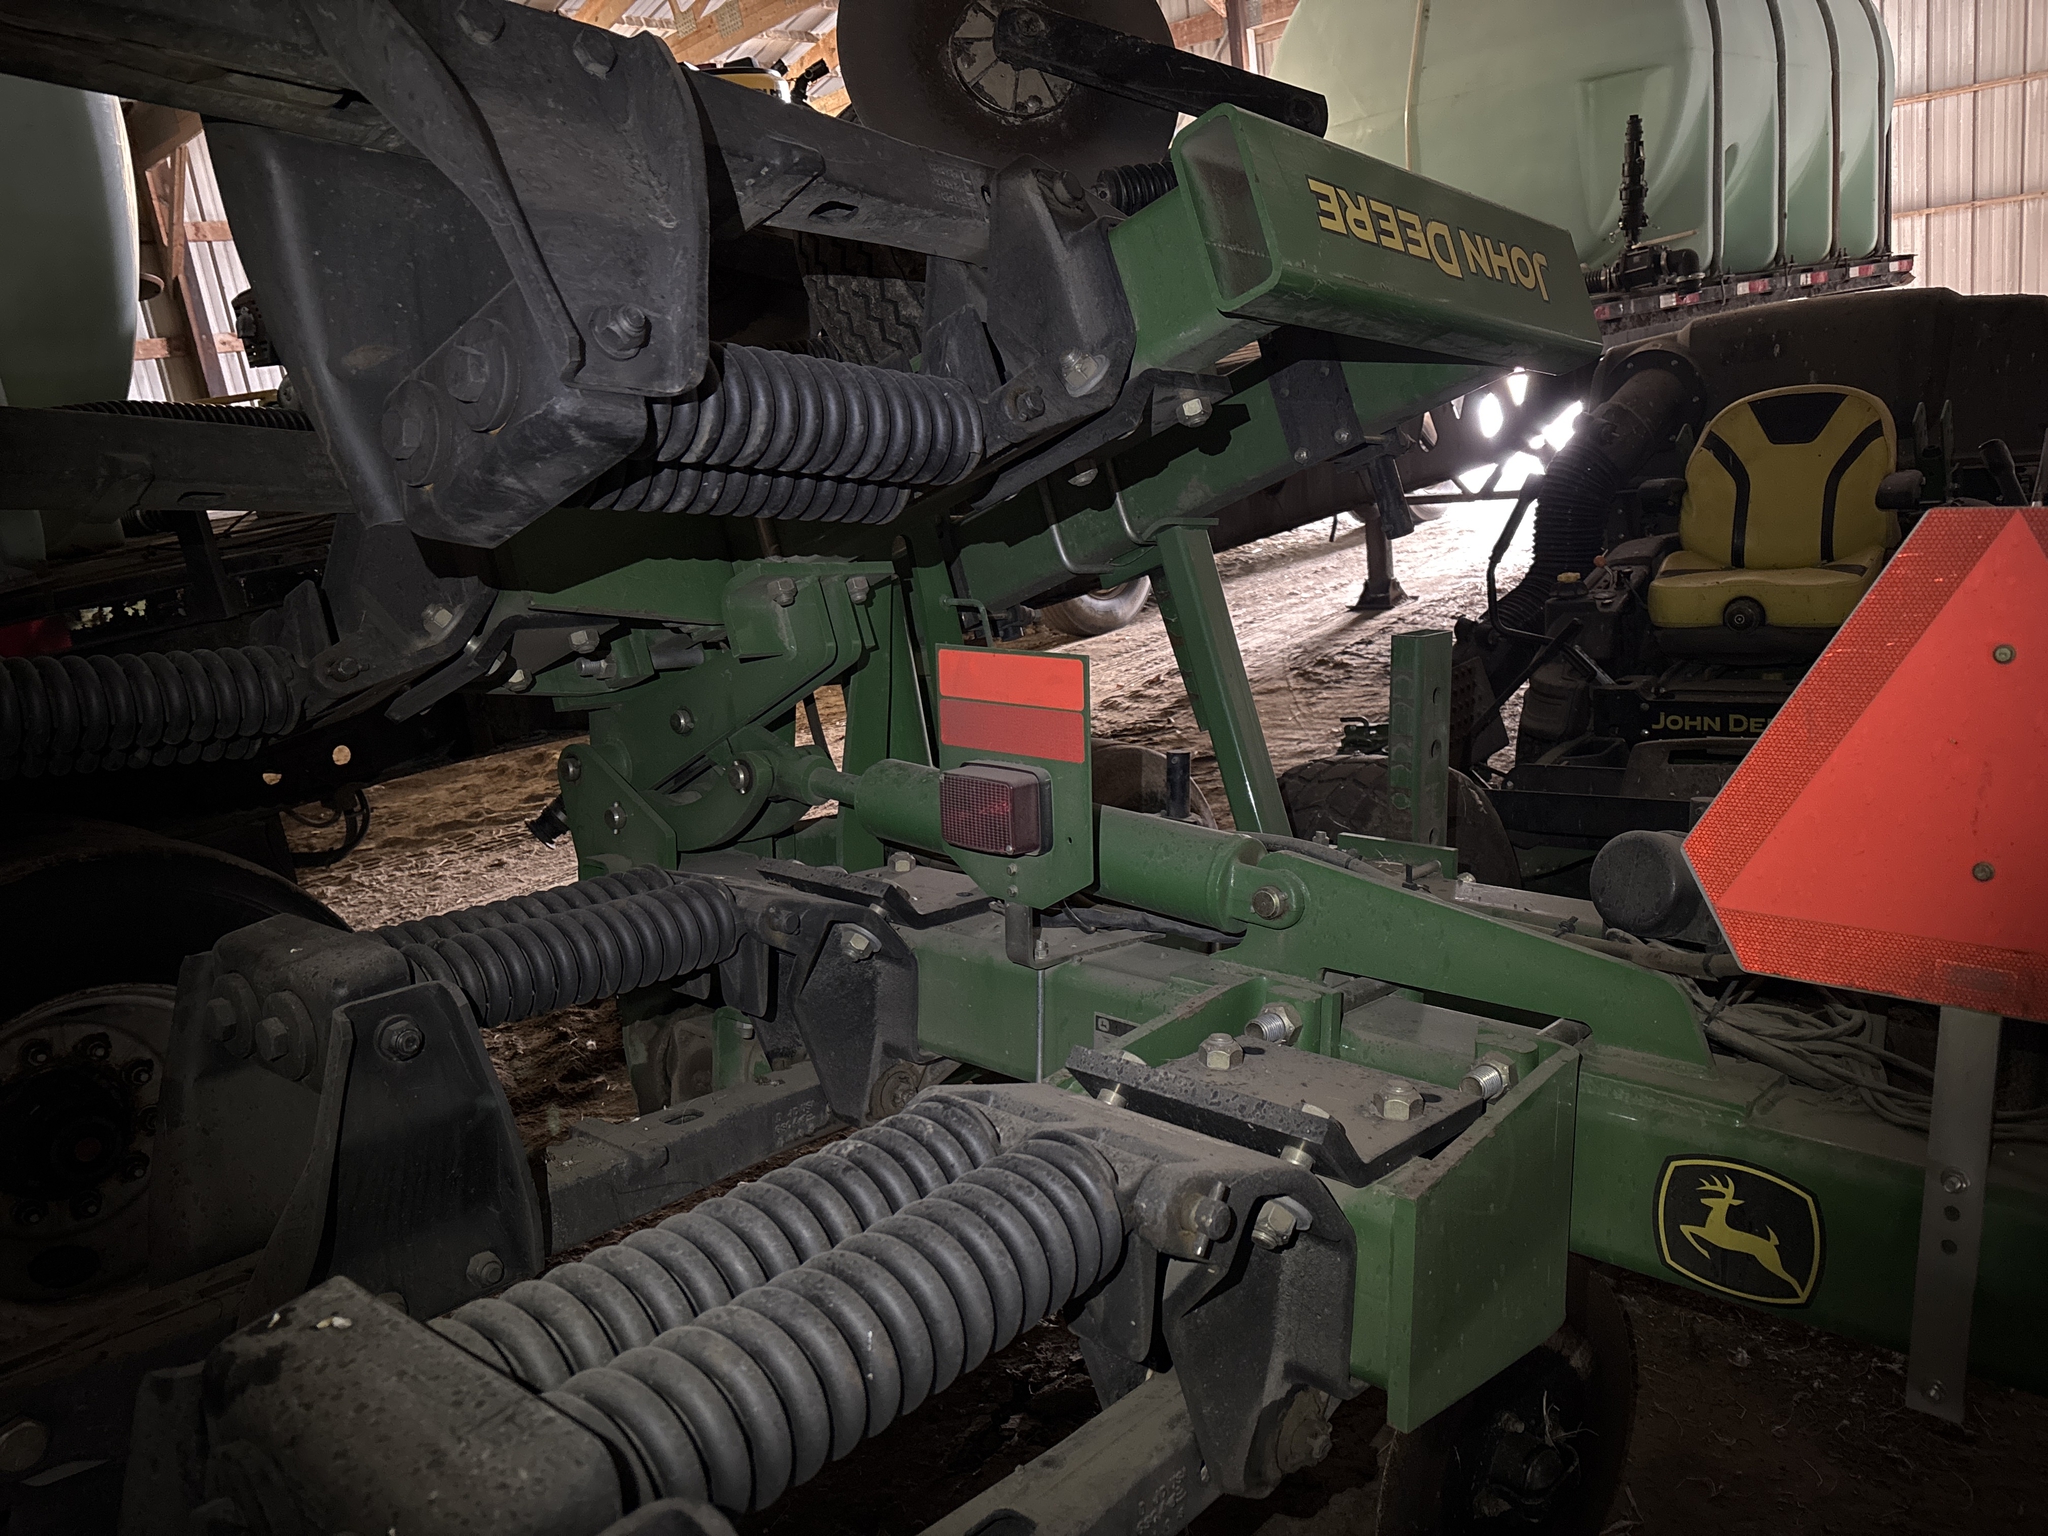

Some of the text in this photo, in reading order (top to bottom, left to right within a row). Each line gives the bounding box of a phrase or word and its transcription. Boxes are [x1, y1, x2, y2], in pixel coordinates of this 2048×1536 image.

[1306, 175, 1550, 302] JOHN DEERE
[1651, 711, 1772, 733] JOHN DE
